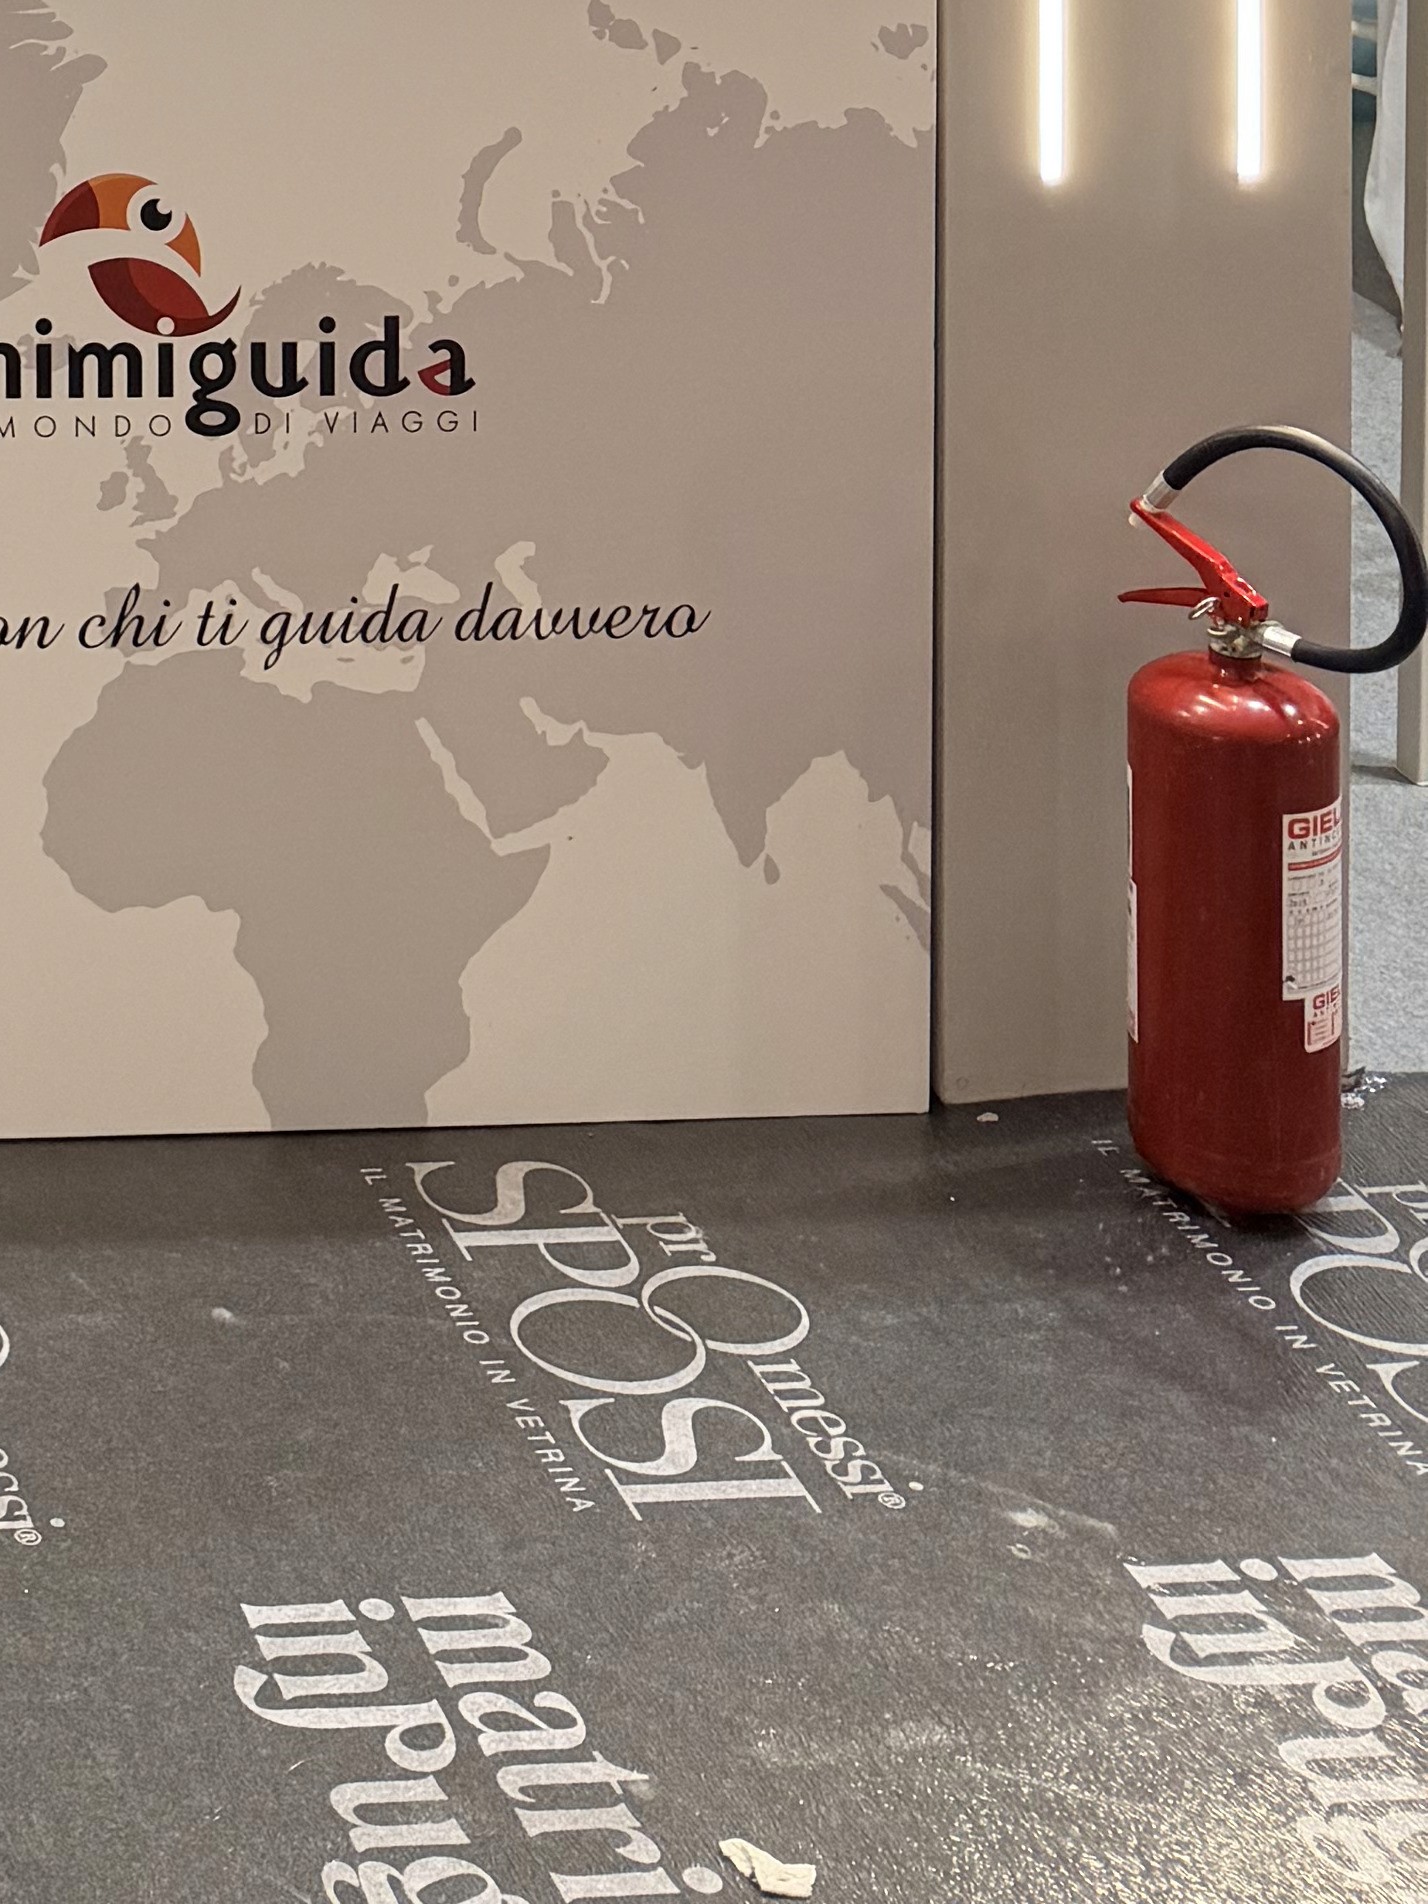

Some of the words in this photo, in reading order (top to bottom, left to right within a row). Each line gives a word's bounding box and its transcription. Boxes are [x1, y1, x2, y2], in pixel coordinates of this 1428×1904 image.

[254, 411, 293, 436] DI
[323, 409, 479, 434] VIAGGI
[78, 583, 184, 652] chi
[194, 592, 248, 648] ti
[261, 583, 441, 673] guida
[453, 583, 711, 644] davvero
[360, 1166, 388, 1187] IL
[378, 1196, 490, 1345] MATRIMONIO
[478, 1358, 516, 1385] IN
[505, 1397, 597, 1513] VETRINA
[405, 1161, 823, 1521] SPOSI
